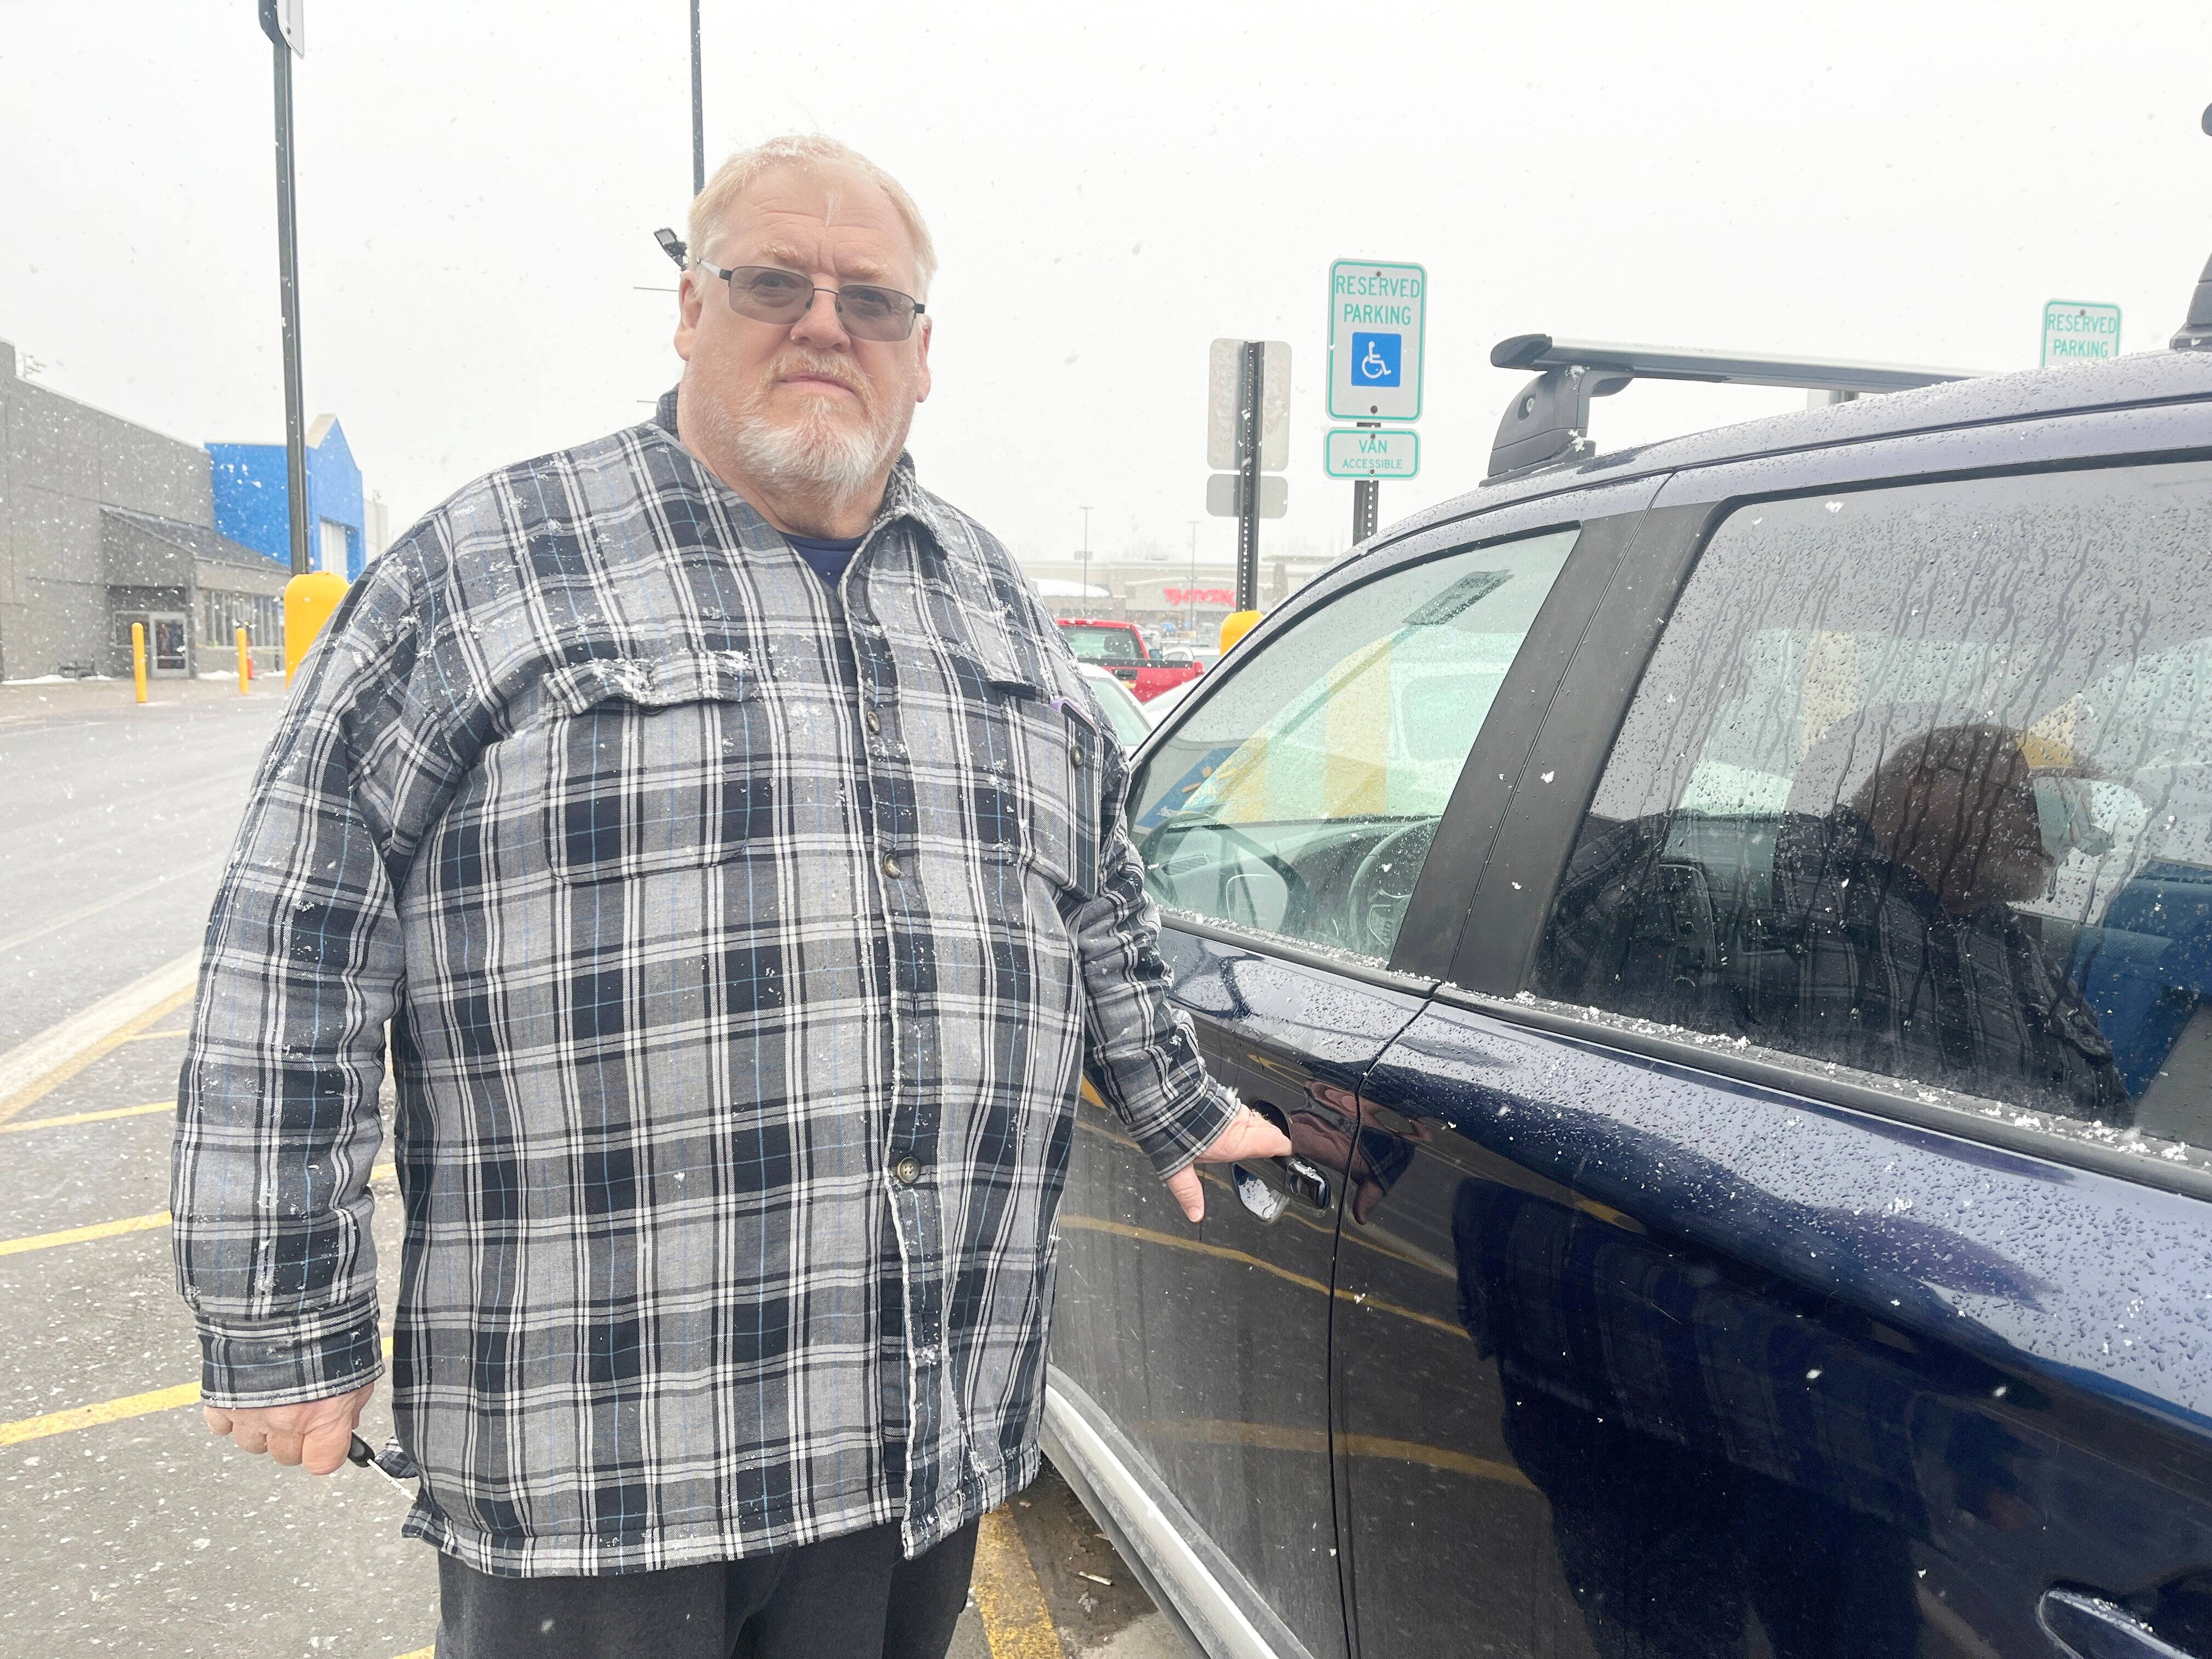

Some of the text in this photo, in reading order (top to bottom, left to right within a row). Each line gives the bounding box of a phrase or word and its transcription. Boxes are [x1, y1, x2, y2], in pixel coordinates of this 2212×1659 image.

[1336, 275, 1420, 298] RESERVED
[1344, 303, 1411, 325] PARKING
[2048, 313, 2117, 334] RESERVED
[2053, 338, 2109, 358] PARKING
[1358, 439, 1387, 454] VAN
[1342, 458, 1402, 469] ACCESSIBLE
